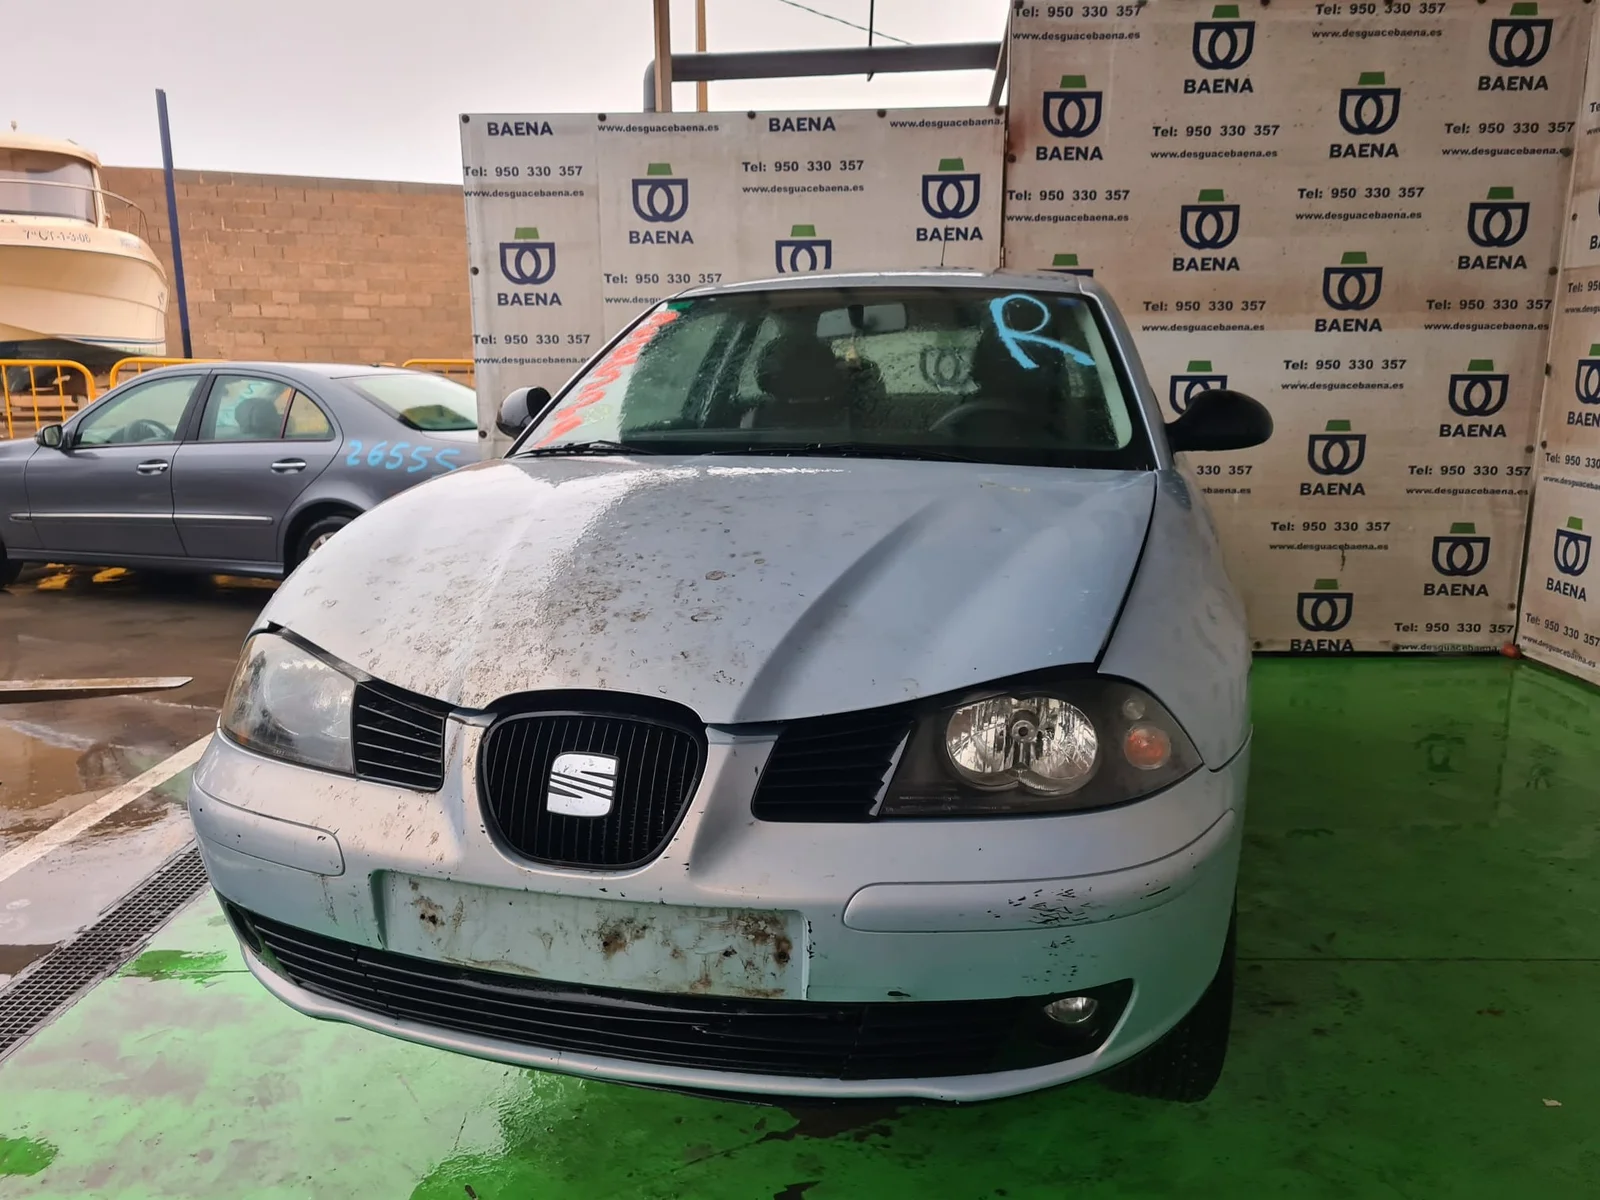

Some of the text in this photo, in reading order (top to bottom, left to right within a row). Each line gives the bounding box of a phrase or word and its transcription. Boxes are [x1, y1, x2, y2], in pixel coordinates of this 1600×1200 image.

[1014, 3, 1143, 18] Tel: 950 330 357
[1315, 0, 1446, 16] Tel: 950 330 357
[1012, 29, 1140, 42] www.desguacebaena.es
[1312, 27, 1442, 39] www.desguacebaena.es
[1184, 78, 1253, 94] BAENA
[1478, 76, 1548, 91] BAENA
[487, 122, 553, 136] BAENA
[598, 122, 719, 134] www.desguacebaena.es
[769, 117, 836, 132] BAENA
[890, 117, 1005, 130] www.desguacebaena.
[1445, 123, 1470, 134] Tel:
[1479, 123, 1505, 133] 950
[1513, 123, 1539, 134] 330
[1548, 121, 1575, 133] 357
[1153, 125, 1280, 137] Tel: 950 330 357
[1036, 146, 1103, 160] BAENA
[1151, 149, 1277, 159] www.desguacebaena.es
[1329, 143, 1399, 158] BAENA
[463, 164, 582, 177] Tel: 950 330 357
[742, 160, 864, 172] Tel: 950 330 357
[464, 187, 584, 199] www.desguacebaena.es
[742, 184, 864, 194] www.desguacebaena.es
[1007, 187, 1130, 203] Tel: 950 330 357
[1298, 187, 1424, 199] Tel: 950 330 357
[1006, 212, 1128, 224] www.desguacebaena.es
[1296, 209, 1421, 221] www.desguacebaena.es
[629, 230, 694, 244] BAENA
[917, 226, 983, 242] BAENA
[1173, 257, 1240, 271] BAENA
[1458, 255, 1527, 269] BAENA
[604, 273, 722, 284] Tel: 950 330 357
[498, 293, 562, 306] BAENA
[1143, 301, 1266, 311] Tel: 950 330 357
[1426, 299, 1552, 310] Tel: 950 330 357
[989, 293, 1097, 370] R
[1142, 323, 1264, 333] www.desguacebaena.es
[1315, 318, 1382, 332] BAENA
[1424, 320, 1549, 332] www.desguacebaena.es
[473, 334, 590, 344] Tel: 950 330 357
[1284, 359, 1406, 370] Tel: 950 330 357
[1281, 381, 1404, 391] www.desguacebaena.es
[1439, 424, 1506, 437] BAENA
[1546, 453, 1560, 463] Tel:
[1565, 454, 1580, 466] 950
[1197, 465, 1252, 475] 330 357
[1408, 465, 1531, 476] Tel: 950 330 357
[1300, 483, 1365, 496] BAENA
[1271, 522, 1390, 531] Tel: 950 330 357
[1424, 584, 1489, 596] BAENA
[1546, 577, 1587, 602] BAENA
[1394, 623, 1514, 634] Tel: 950 330 357
[1526, 613, 1540, 625] Tel:
[1544, 619, 1559, 632] 950
[1563, 625, 1579, 640] 330
[1290, 638, 1354, 652] BAENA
